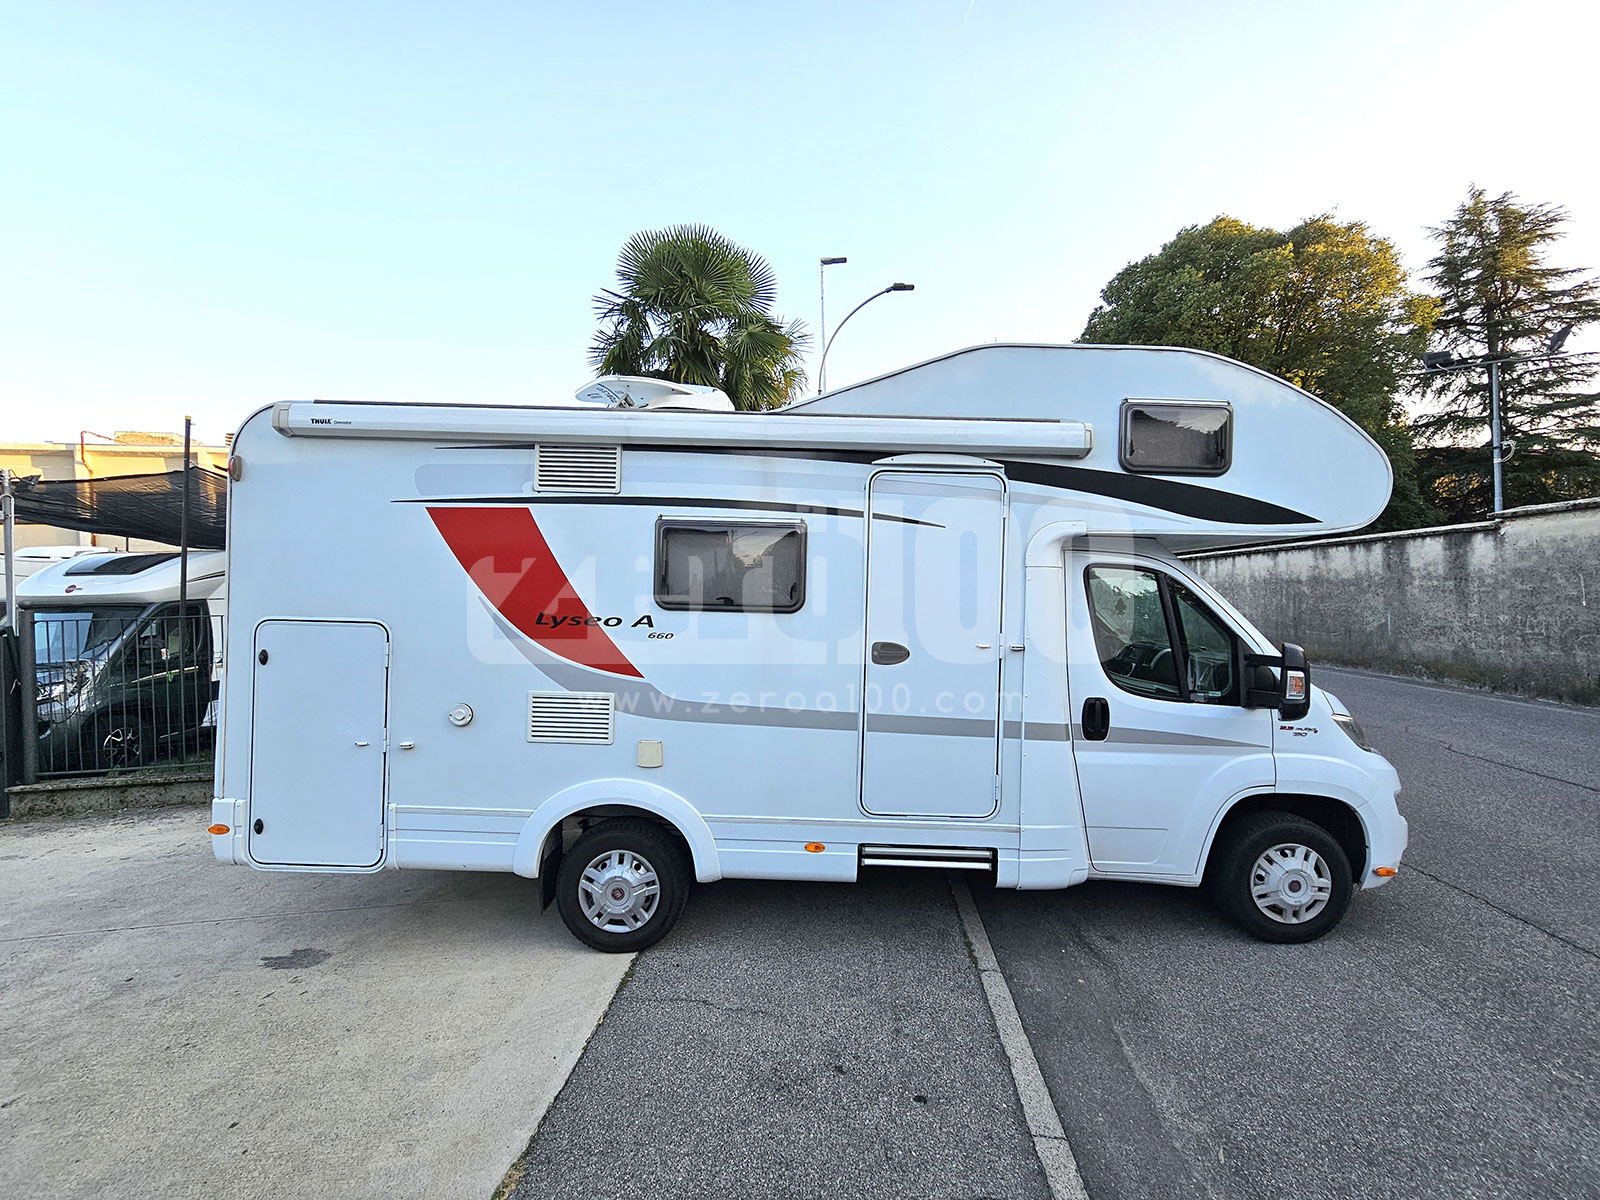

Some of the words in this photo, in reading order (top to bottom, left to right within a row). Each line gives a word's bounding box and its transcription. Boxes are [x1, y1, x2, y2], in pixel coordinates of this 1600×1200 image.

[535, 612, 623, 629] Lyseo
[630, 615, 654, 628] A
[647, 632, 674, 640] 660
